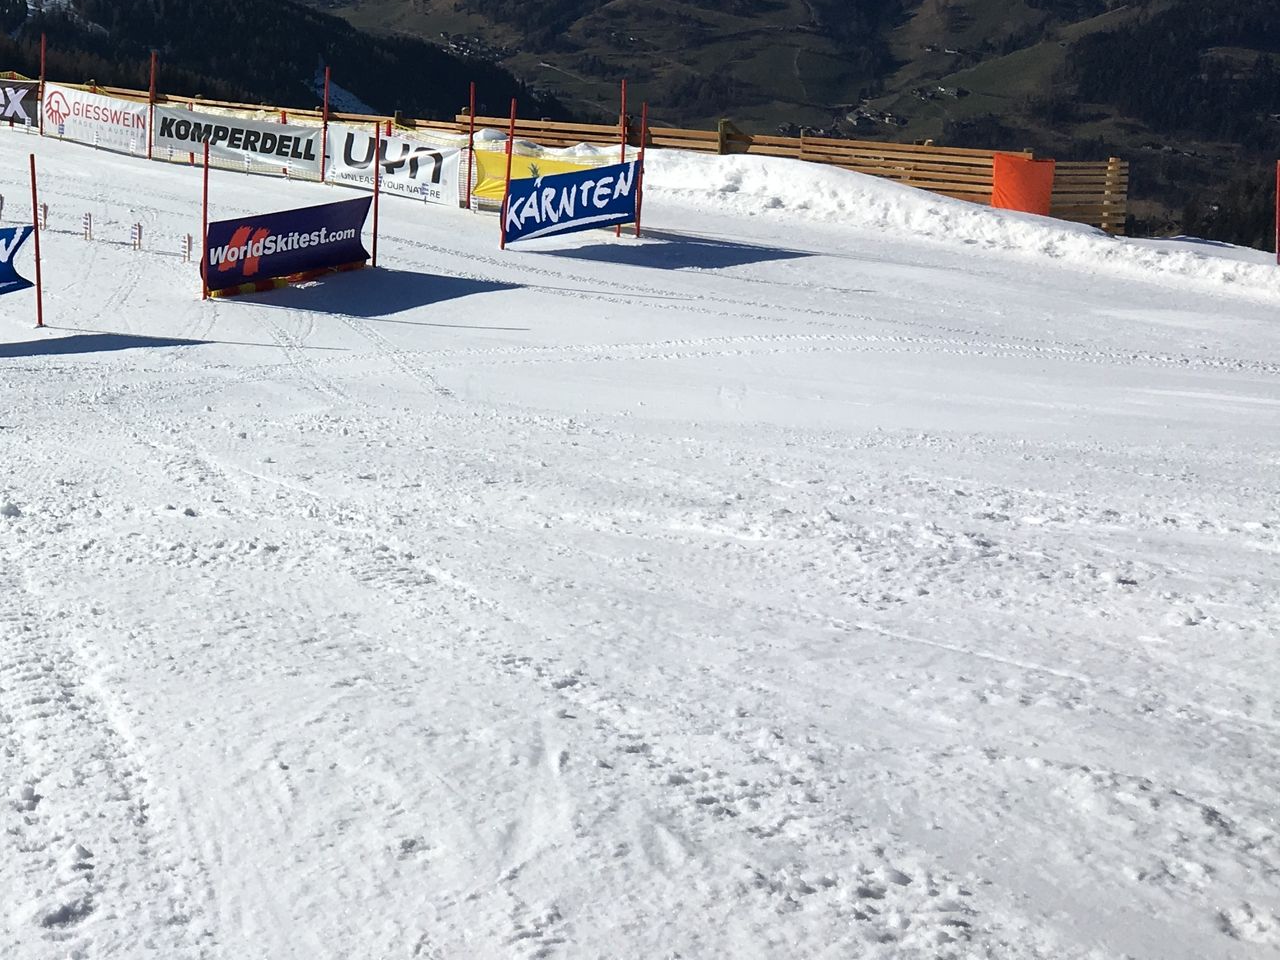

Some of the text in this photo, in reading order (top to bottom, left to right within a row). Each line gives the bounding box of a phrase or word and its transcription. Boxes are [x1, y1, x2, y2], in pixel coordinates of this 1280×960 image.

[72, 101, 146, 130] GIESSWEIN
[72, 119, 93, 128] MADE
[108, 127, 145, 139] AUSTRIA
[159, 116, 316, 161] KOMPERDELL
[340, 171, 380, 186] UNLEAS
[381, 179, 405, 192] YOUR
[506, 161, 635, 233] KÄRNTEN
[209, 227, 356, 266] WorldSkitest.com
